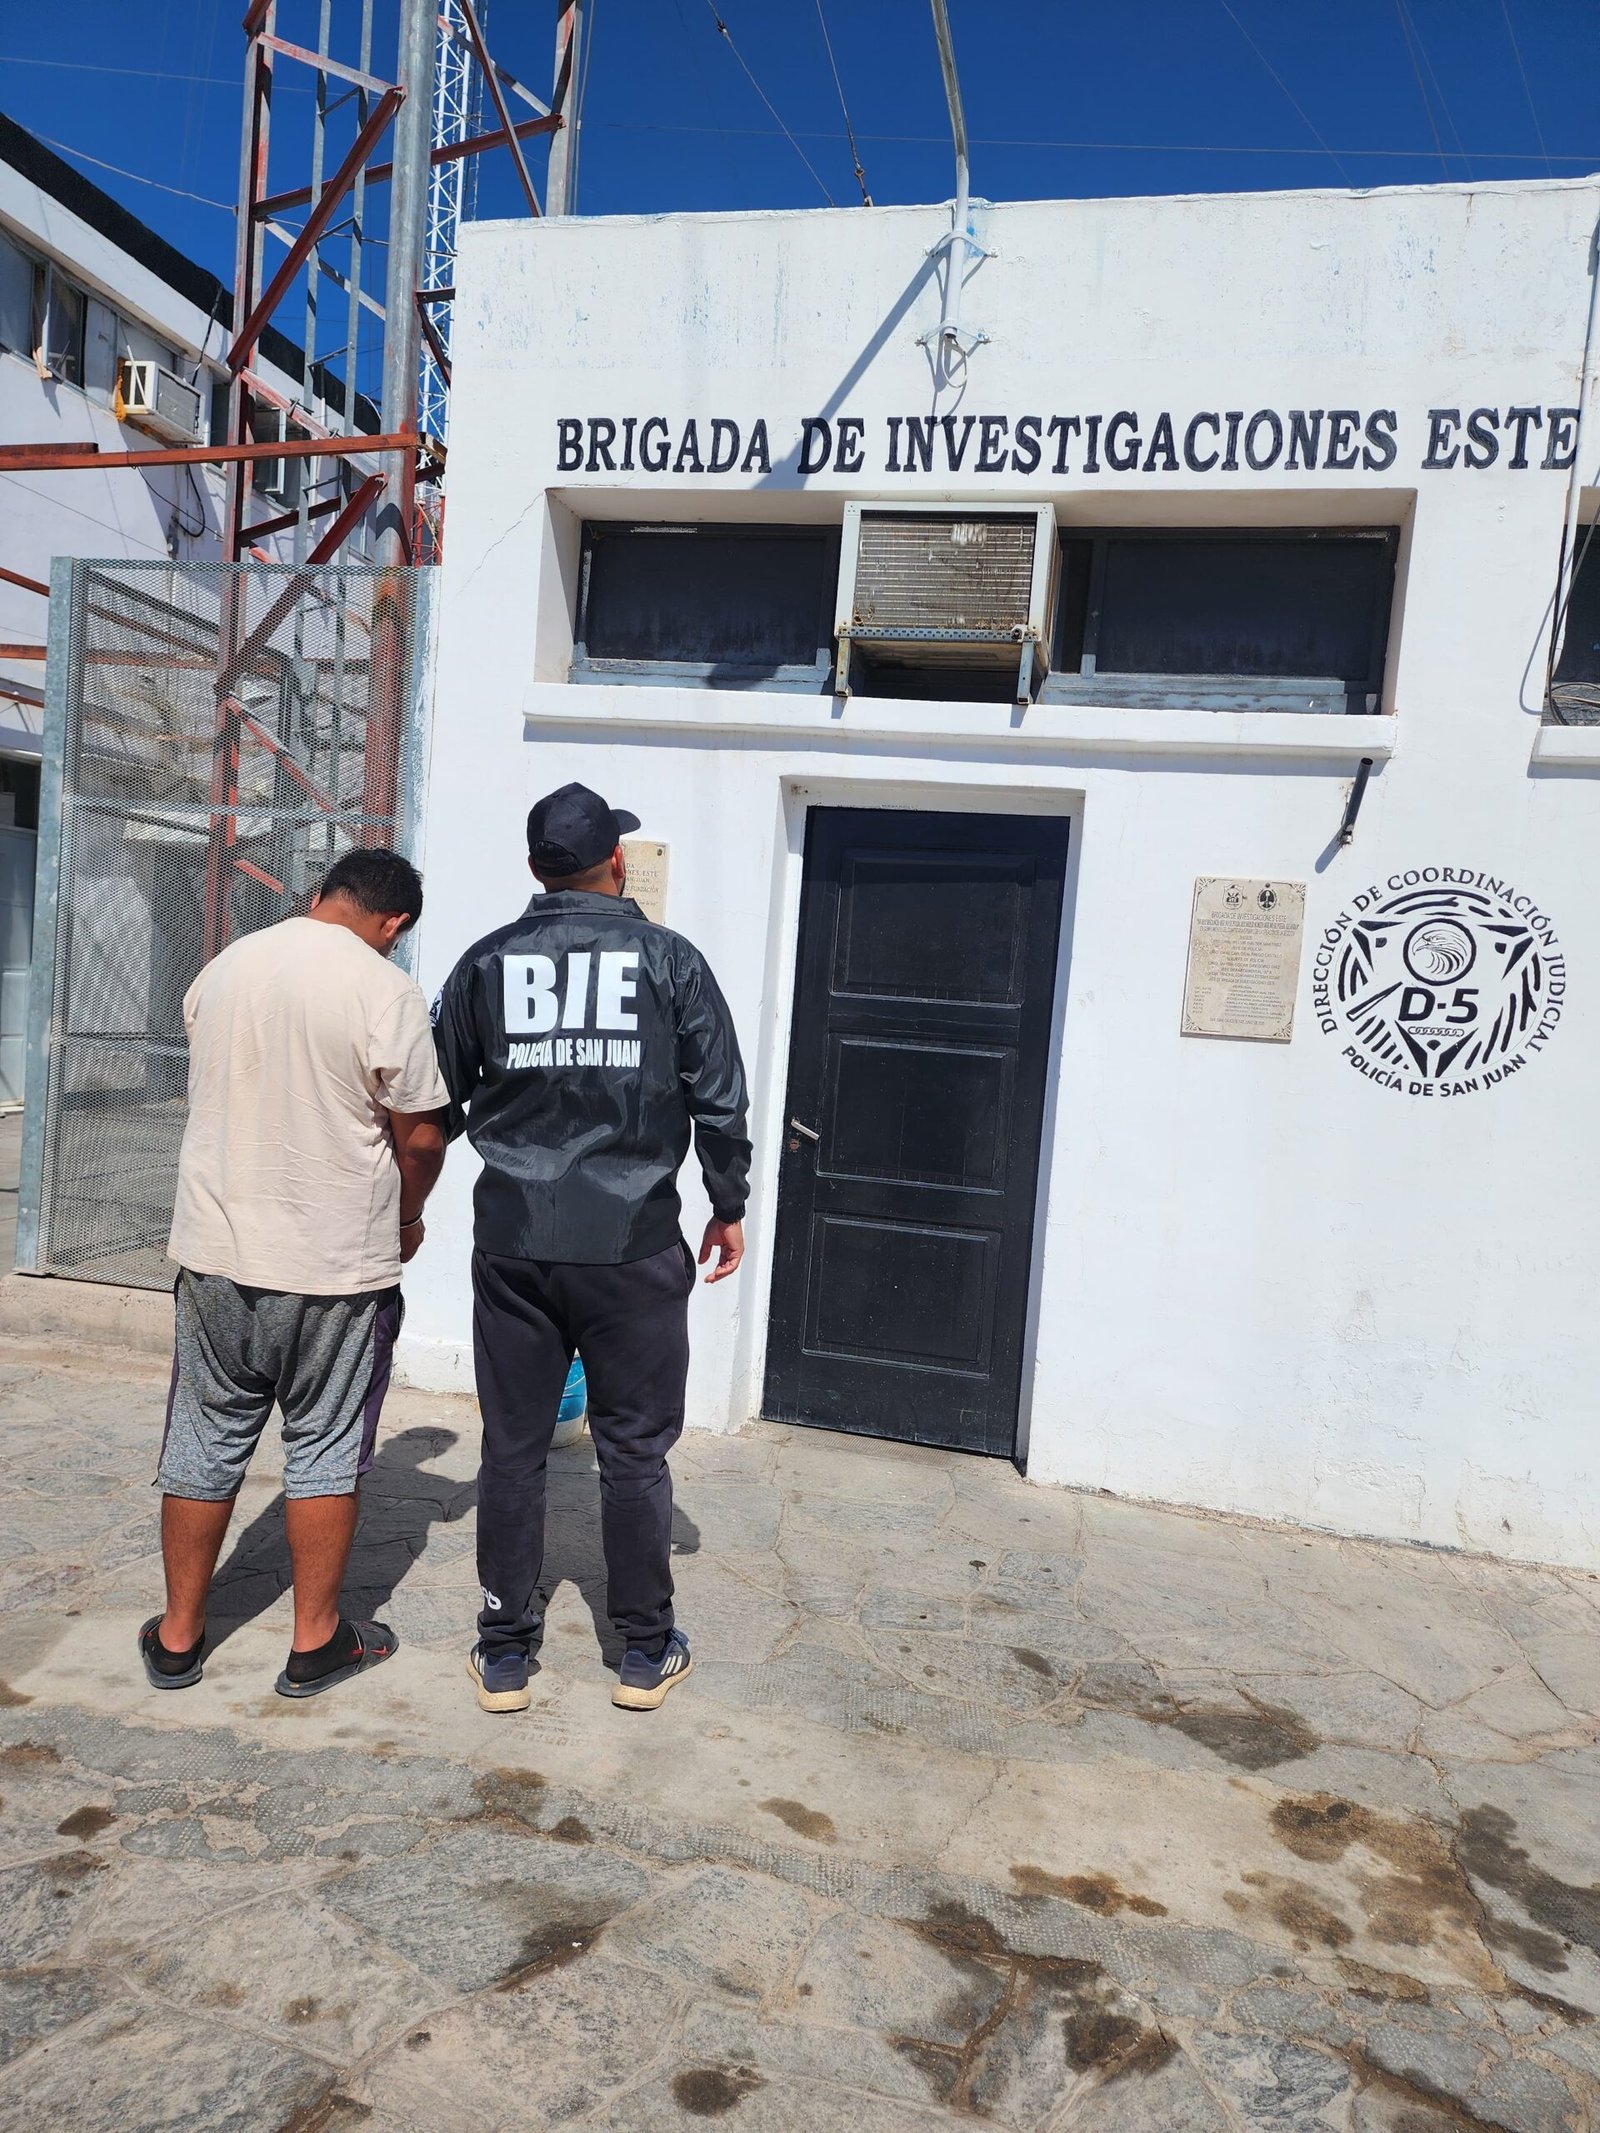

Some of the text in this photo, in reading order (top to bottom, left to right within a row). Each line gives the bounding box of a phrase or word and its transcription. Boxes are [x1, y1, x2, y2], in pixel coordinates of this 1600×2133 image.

[556, 405, 1580, 475] BRIGADA DE INVESTIGACIONES ESTE
[1313, 867, 1566, 1054] DIRECCIÓN DE COORDINACIÓN JUDICIAL
[1397, 987, 1479, 1023] D-5
[555, 1038, 573, 1066] DE
[576, 1038, 603, 1066] SAN
[605, 1040, 641, 1068] JUAN
[1341, 1045, 1527, 1098] POLICÍA DE SAN JUAN
